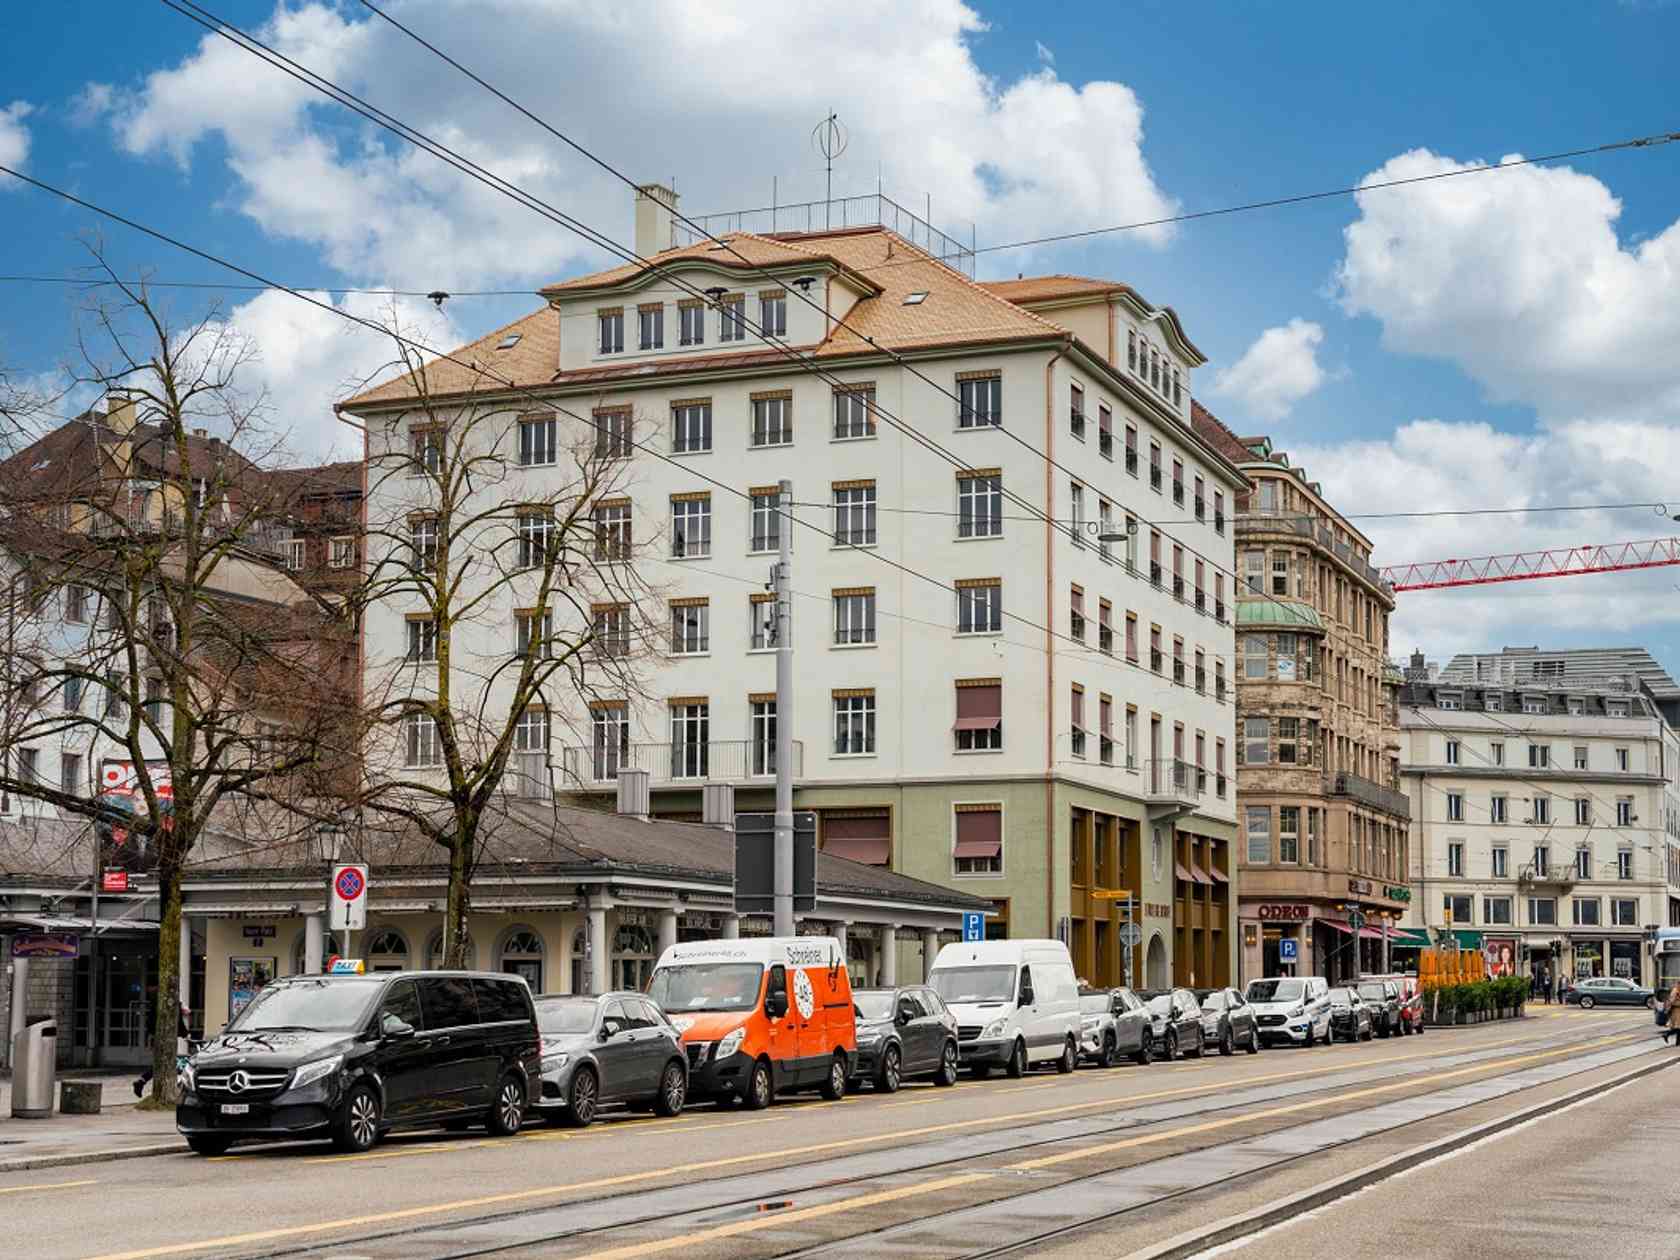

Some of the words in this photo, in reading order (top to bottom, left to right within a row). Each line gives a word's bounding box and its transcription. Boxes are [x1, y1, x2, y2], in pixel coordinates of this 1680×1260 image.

[1259, 905, 1309, 920] ODEON
[970, 915, 979, 928] P
[1284, 942, 1292, 955] P
